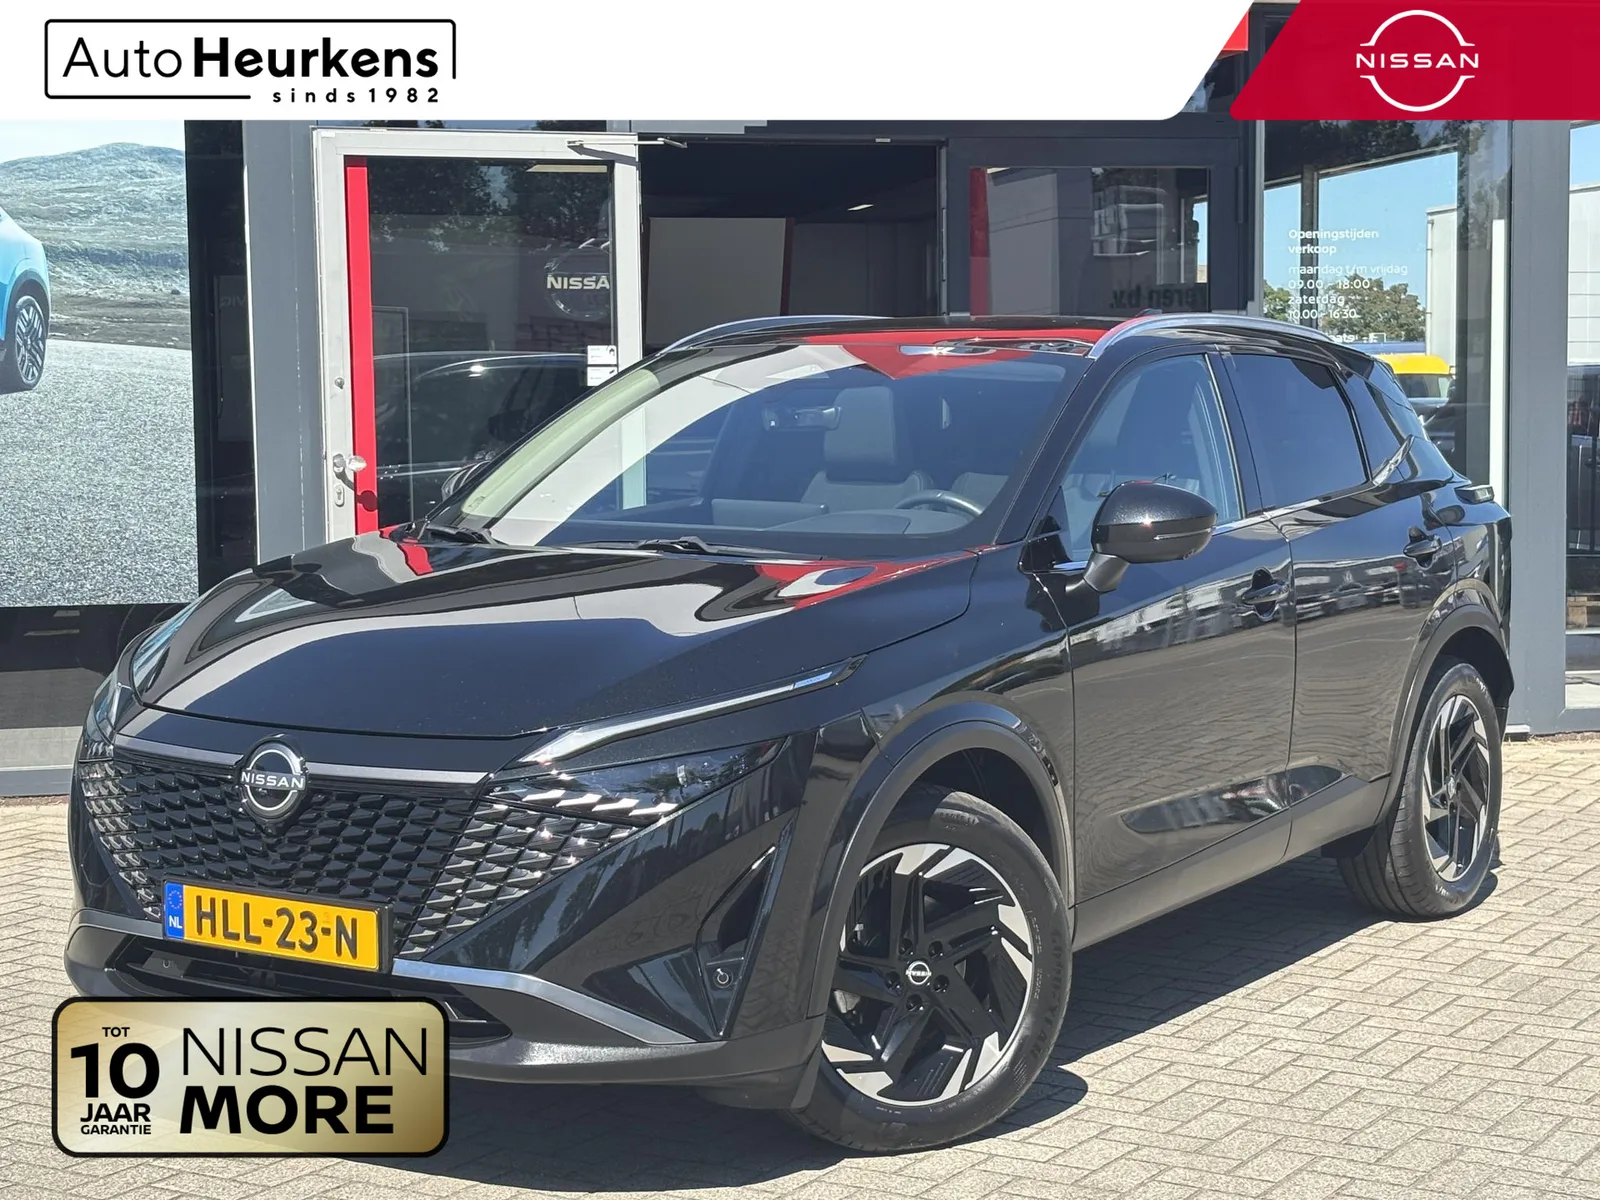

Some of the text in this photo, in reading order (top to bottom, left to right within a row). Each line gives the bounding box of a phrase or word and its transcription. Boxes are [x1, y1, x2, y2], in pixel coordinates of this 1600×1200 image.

[1288, 229, 1379, 241] Openingstijden
[1288, 243, 1337, 255] verkoop
[1288, 264, 1408, 276] maandag t/m vrijdag
[547, 275, 610, 290] NISSA
[1338, 279, 1370, 289] 18:00
[1288, 294, 1345, 306] zaterdag
[241, 771, 305, 790] NISSAN
[169, 894, 358, 961] NL HLL-23-N
